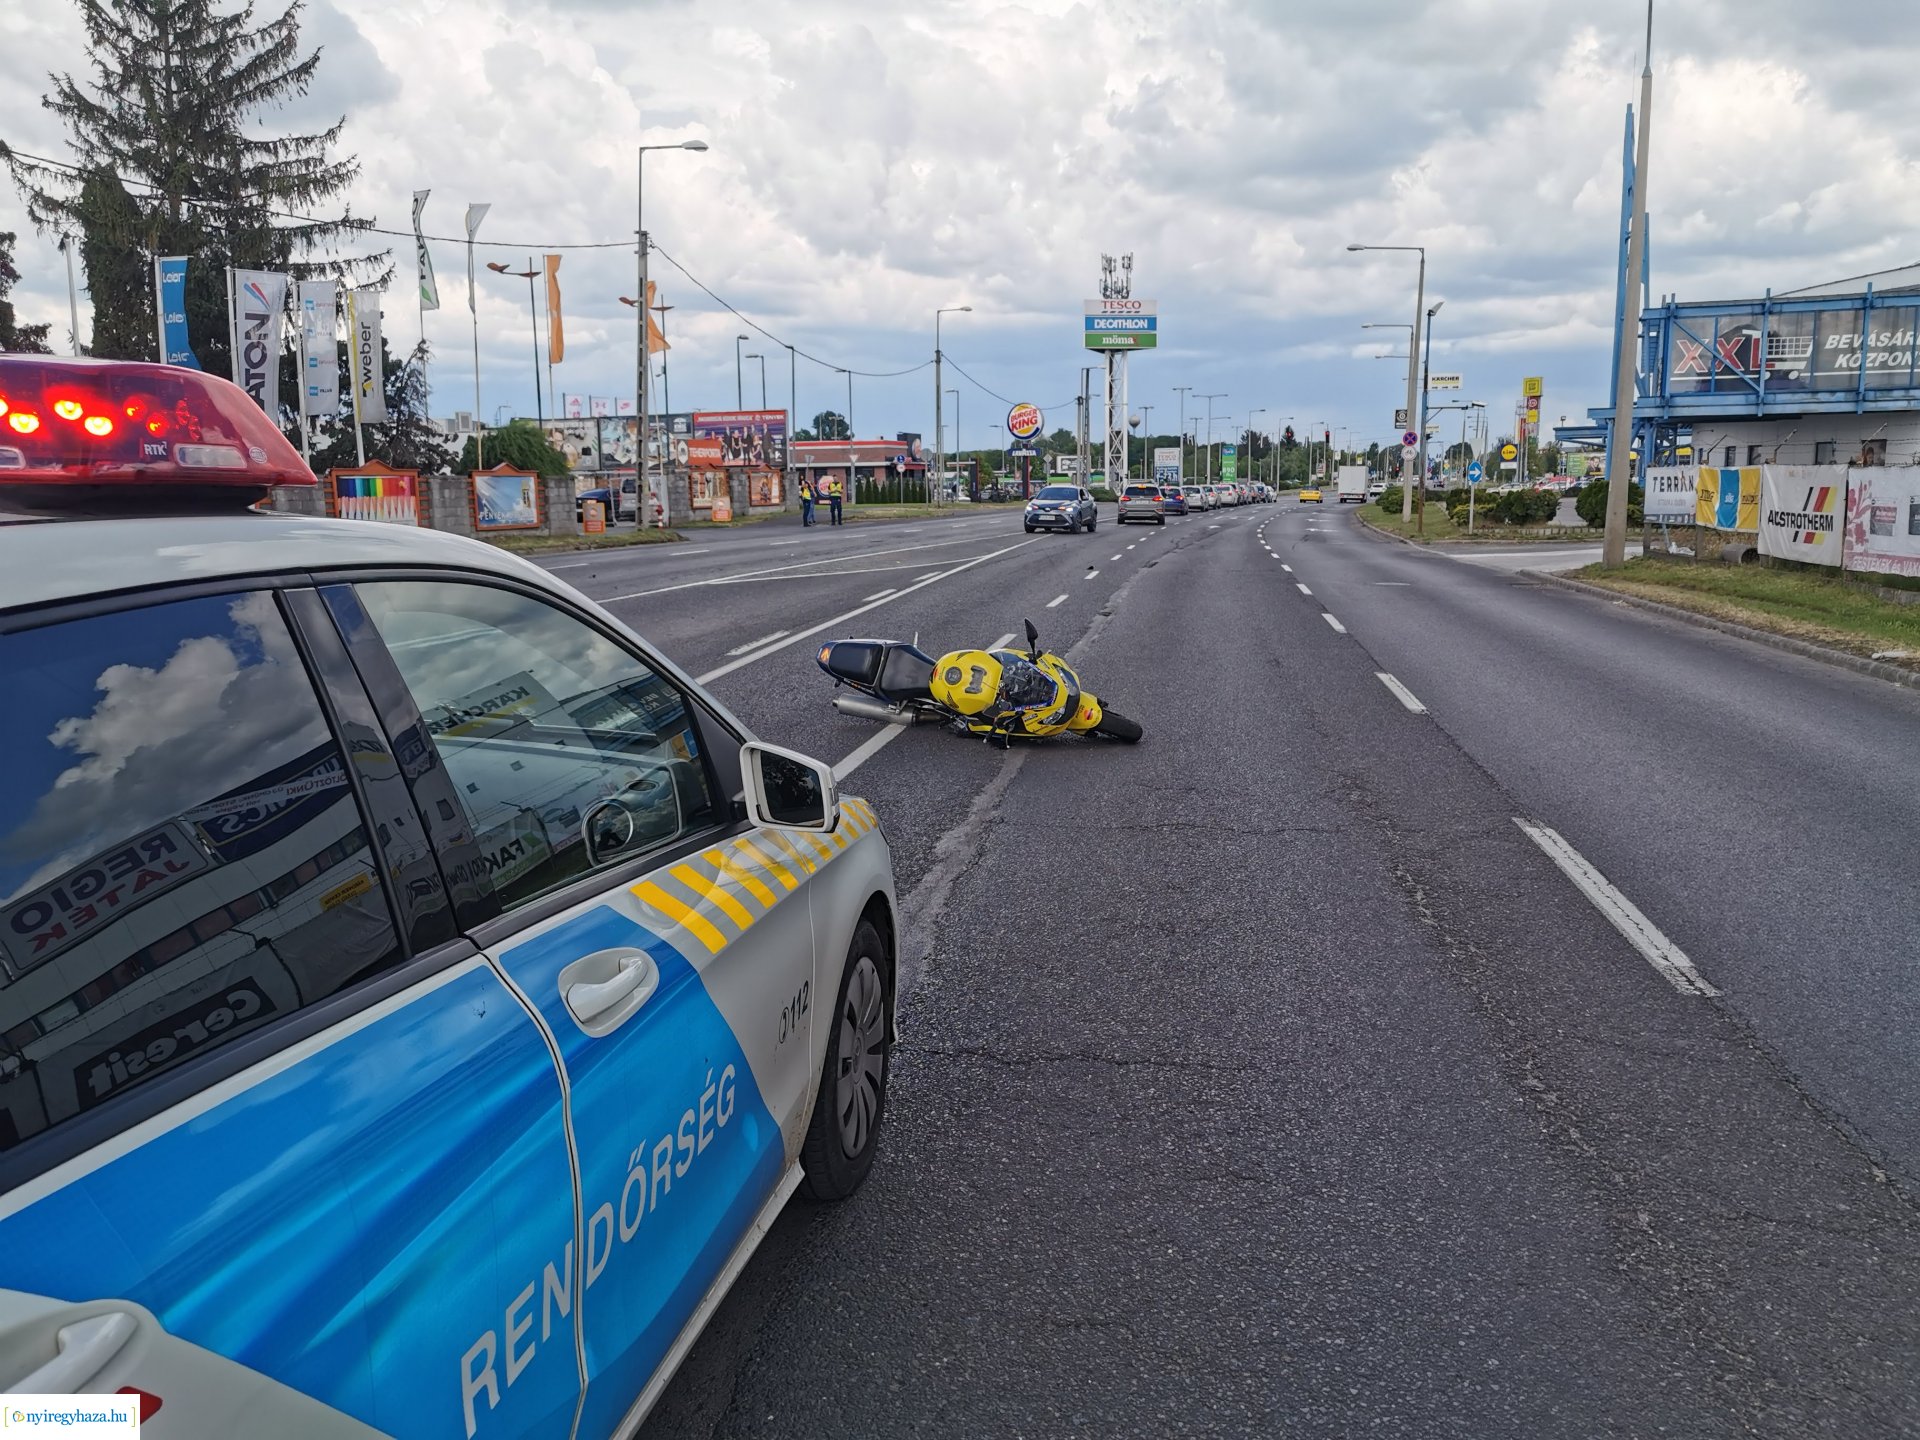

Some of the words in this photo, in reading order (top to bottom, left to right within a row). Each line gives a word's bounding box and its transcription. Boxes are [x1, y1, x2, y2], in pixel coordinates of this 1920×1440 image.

[1101, 300, 1142, 310] TESCO
[1094, 318, 1148, 329] DECATHLON
[1010, 408, 1038, 422] BURGER
[1011, 415, 1038, 432] KING
[790, 979, 809, 1033] 112
[460, 1063, 736, 1440] RENDŐRSÉG
